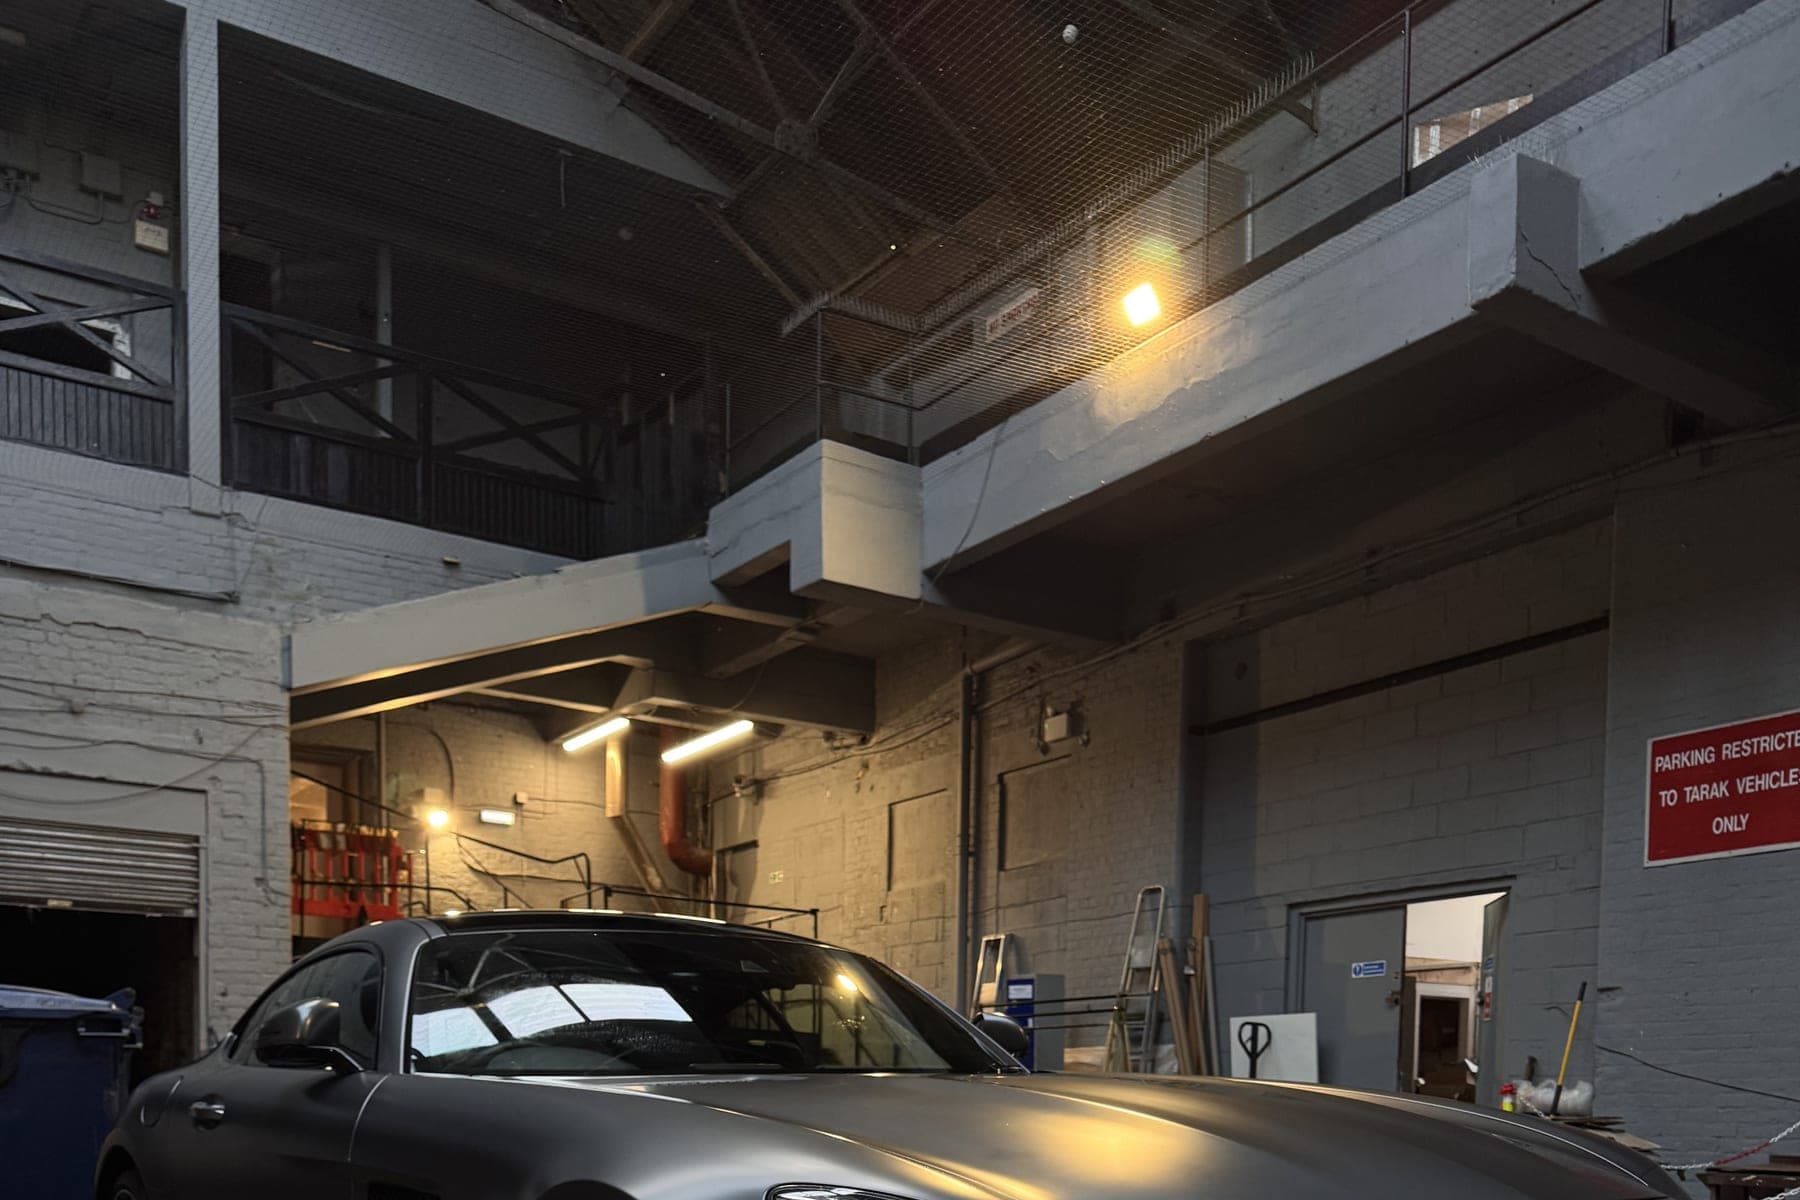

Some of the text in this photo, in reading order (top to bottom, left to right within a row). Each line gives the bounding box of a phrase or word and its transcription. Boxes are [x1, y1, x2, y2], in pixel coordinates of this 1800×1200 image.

[1655, 746, 1716, 773] PARKING
[1659, 767, 1800, 807] TO TARAK VEHICLE
[1712, 813, 1750, 835] ONLY
